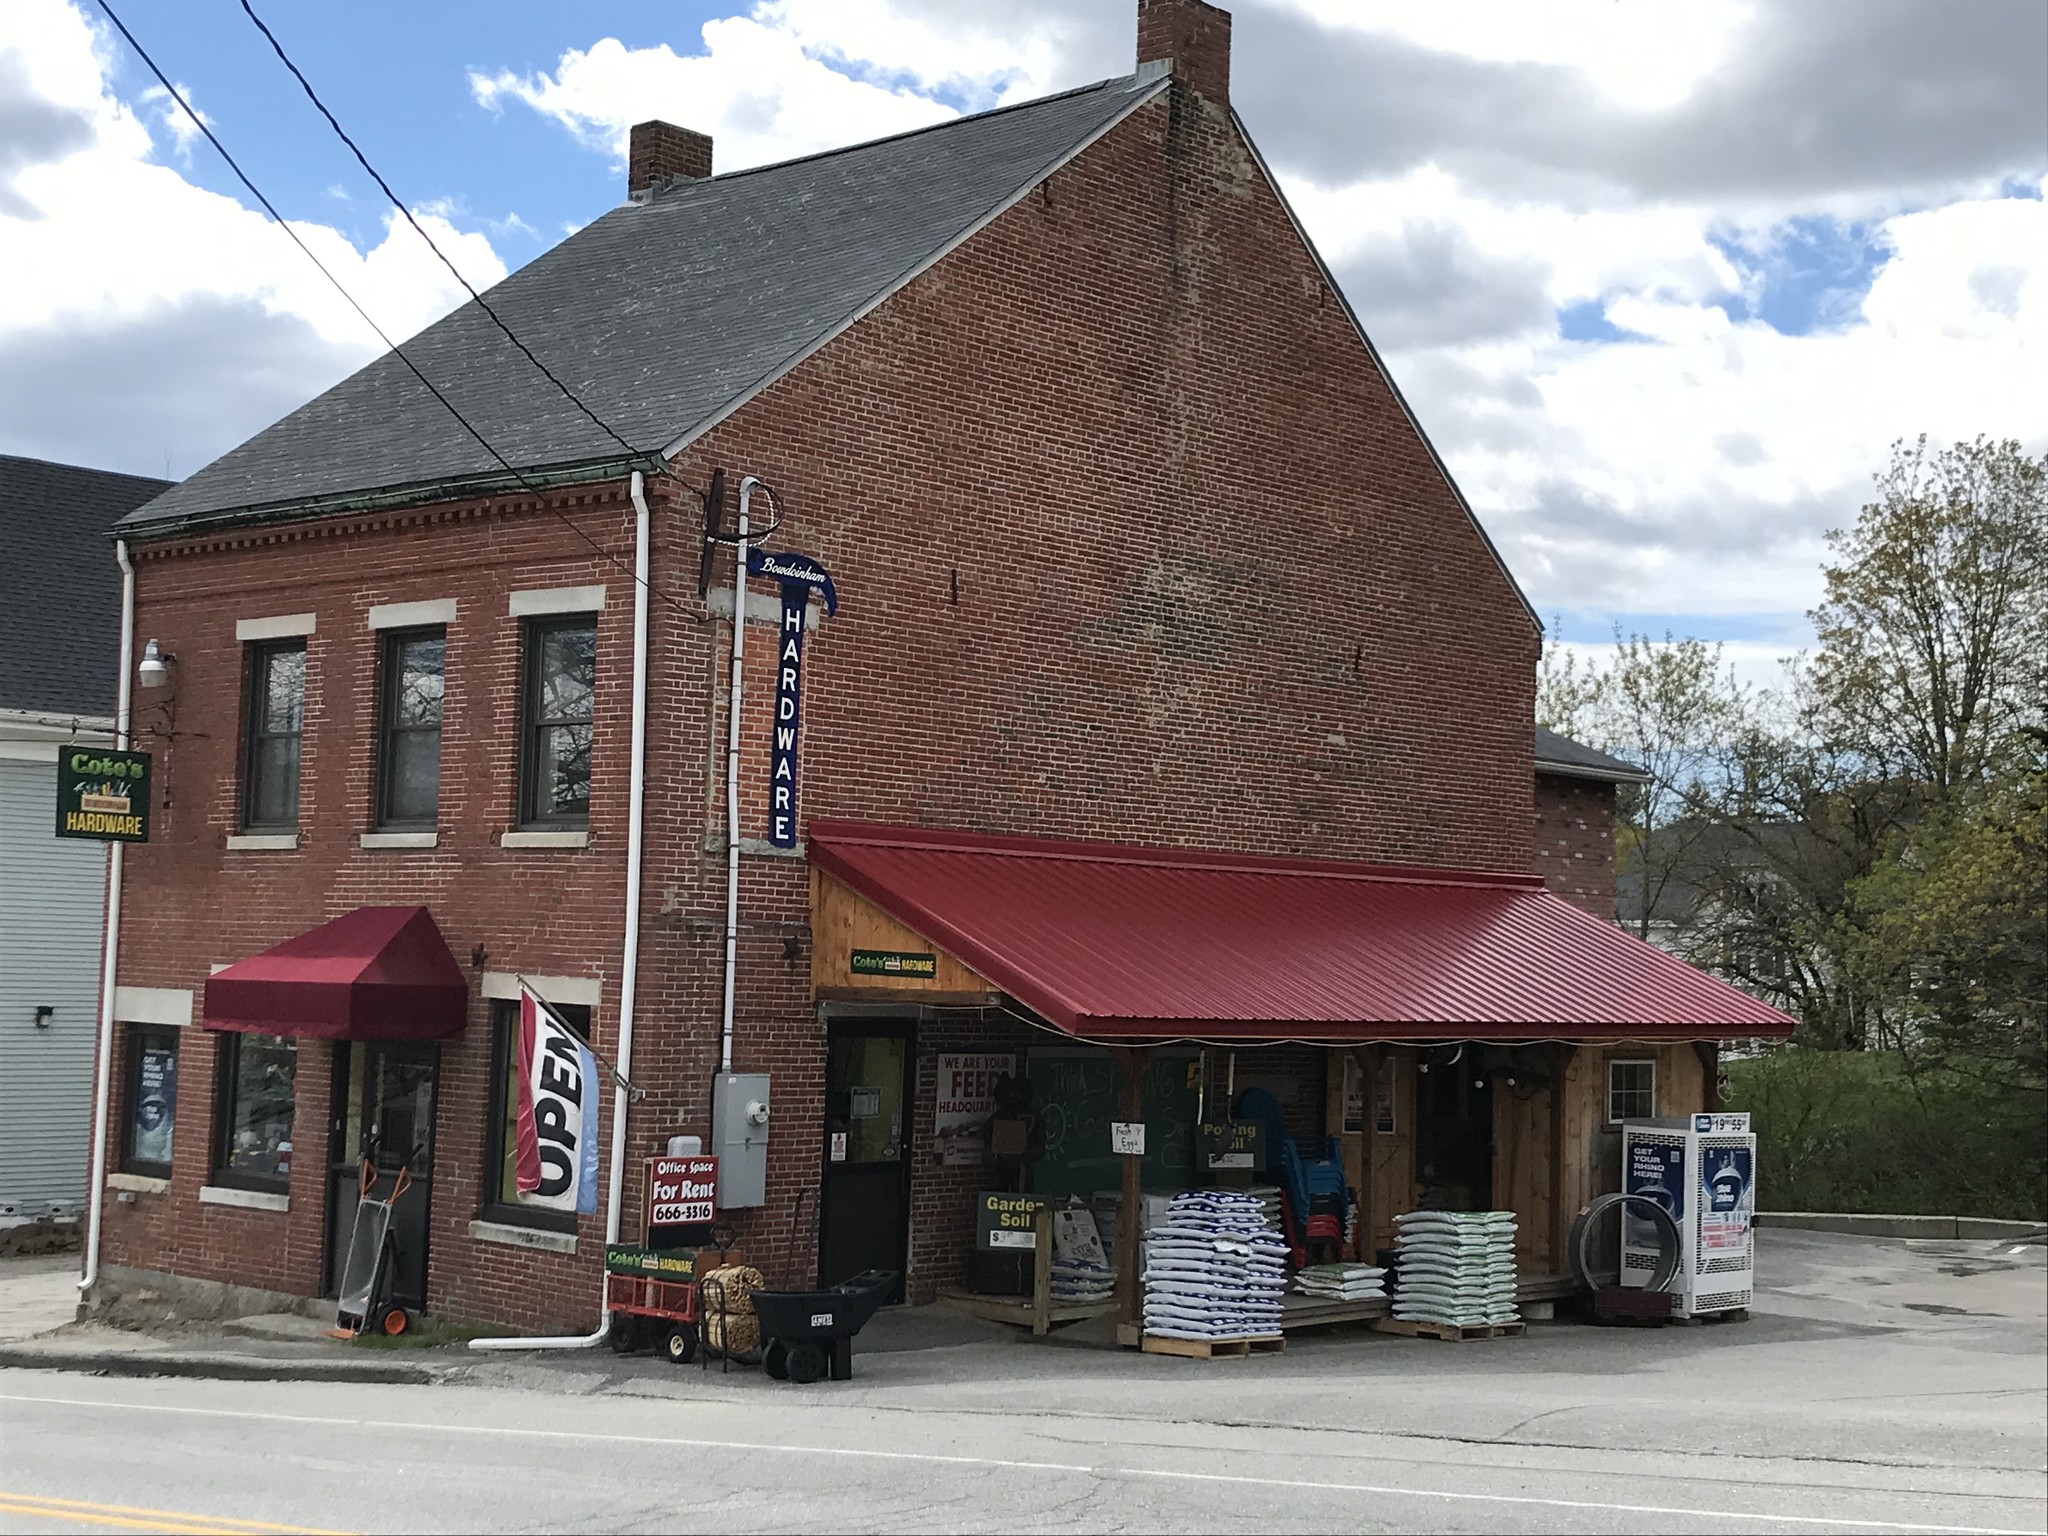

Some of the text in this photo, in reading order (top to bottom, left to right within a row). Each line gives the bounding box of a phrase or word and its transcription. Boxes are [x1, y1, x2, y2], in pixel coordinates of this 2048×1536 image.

[760, 557, 826, 583] Bowdoinham
[775, 608, 800, 840] HARDWARE
[71, 753, 144, 778] Cote's
[66, 811, 143, 835] HARDWARE
[901, 959, 934, 973] HARDWARE
[944, 1057, 1010, 1069] WE ARE YOUR
[532, 1016, 583, 1197] OPEN
[1121, 1137, 1138, 1151] Eggs
[1633, 1147, 1654, 1156] GET
[1633, 1155, 1661, 1163] YOUR
[1633, 1162, 1665, 1172] RHINO
[657, 1161, 714, 1175] Office Space
[653, 1180, 715, 1200] For Rent
[986, 1196, 1045, 1212] Garde
[656, 1204, 711, 1221] 666-3316
[1000, 1212, 1030, 1227] Soil
[659, 1257, 693, 1273] HARDWARE
